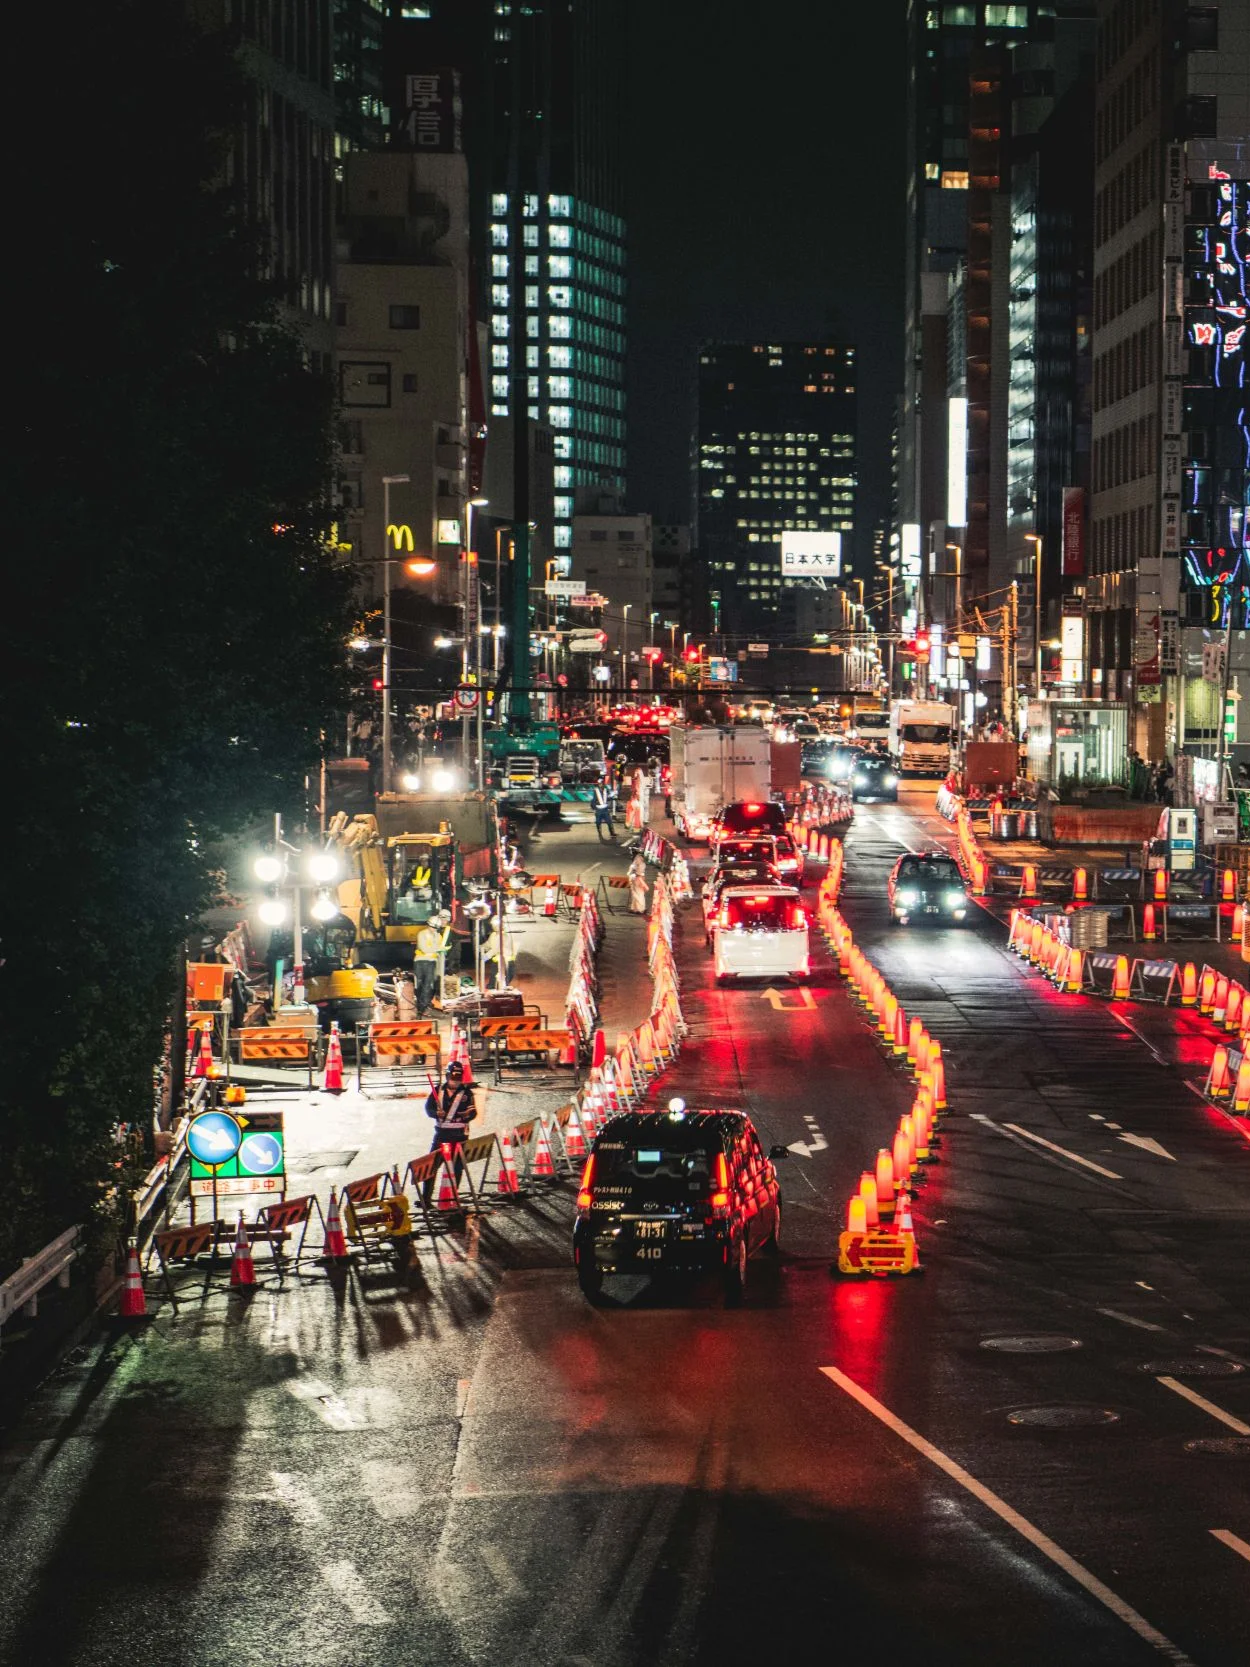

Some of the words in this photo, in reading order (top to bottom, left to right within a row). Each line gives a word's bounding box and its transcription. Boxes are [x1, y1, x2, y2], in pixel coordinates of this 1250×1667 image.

[785, 552, 836, 567] 日本大学
[202, 1178, 275, 1194] 道路工事中
[636, 1247, 662, 1259] 410
